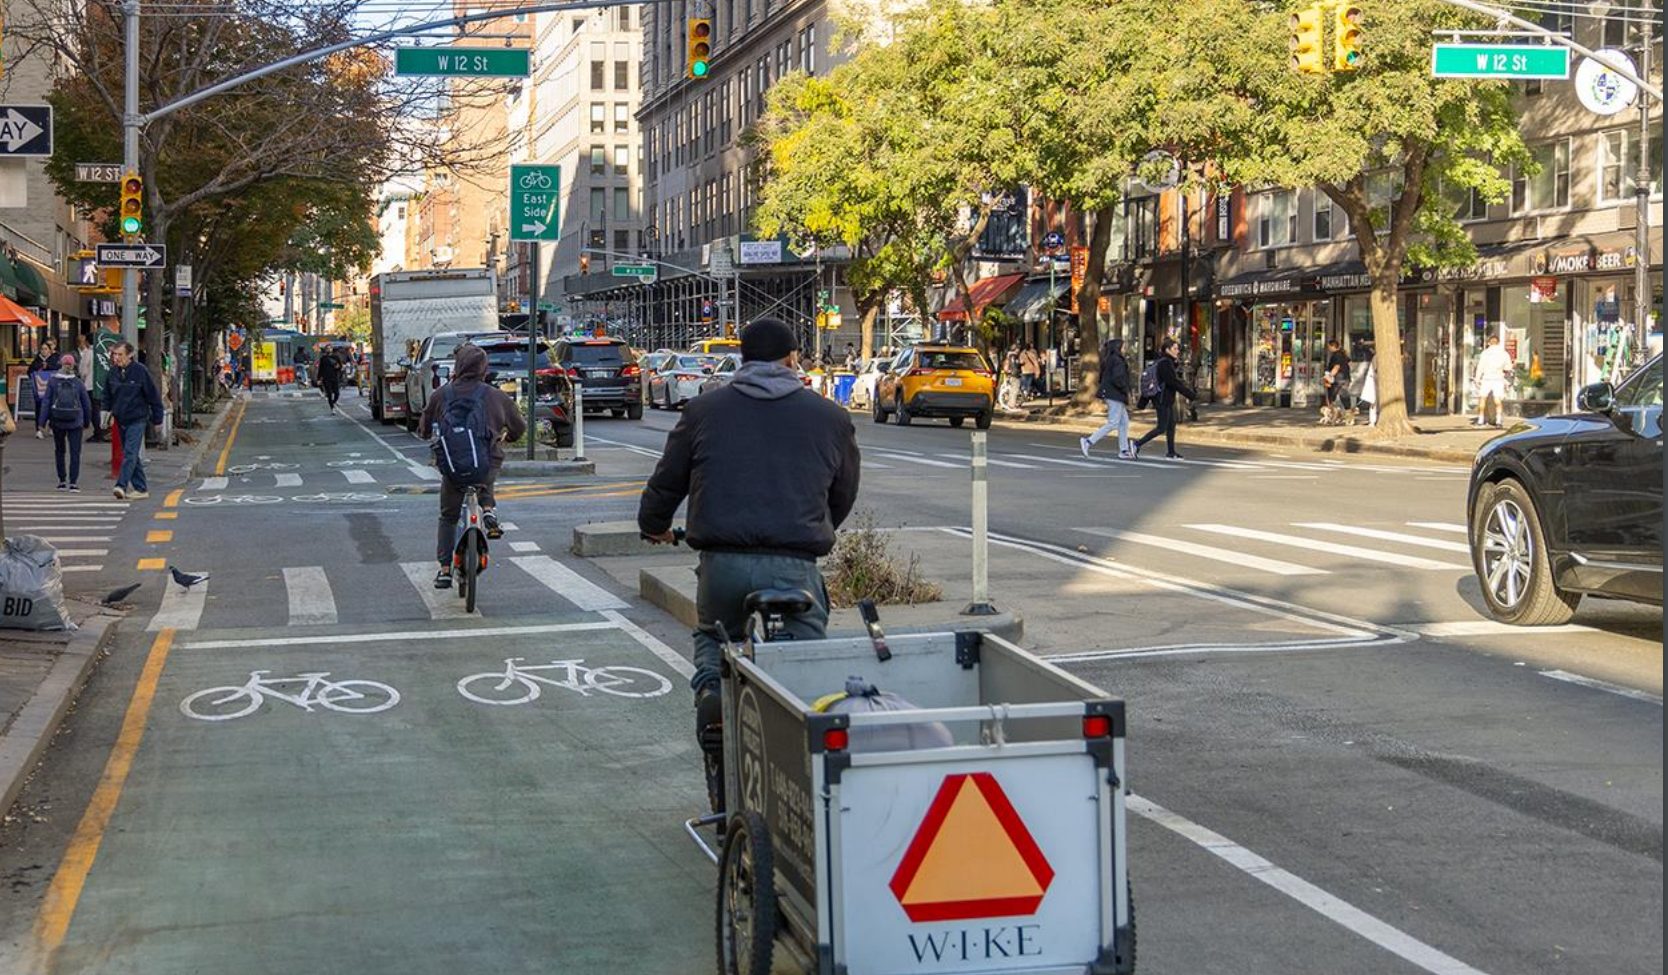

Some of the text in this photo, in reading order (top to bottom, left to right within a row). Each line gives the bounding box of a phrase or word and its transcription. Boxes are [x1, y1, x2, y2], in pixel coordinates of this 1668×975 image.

[437, 55, 488, 71] W 12 St
[1476, 53, 1527, 71] W 12 St
[0, 121, 28, 140] AY
[78, 167, 120, 181] W 12 ST
[523, 193, 547, 204] East
[524, 206, 547, 217] Side
[106, 251, 154, 260] ONE WAY
[1548, 255, 1589, 272] SMOKE
[3, 596, 32, 616] BID
[744, 752, 763, 814] 23
